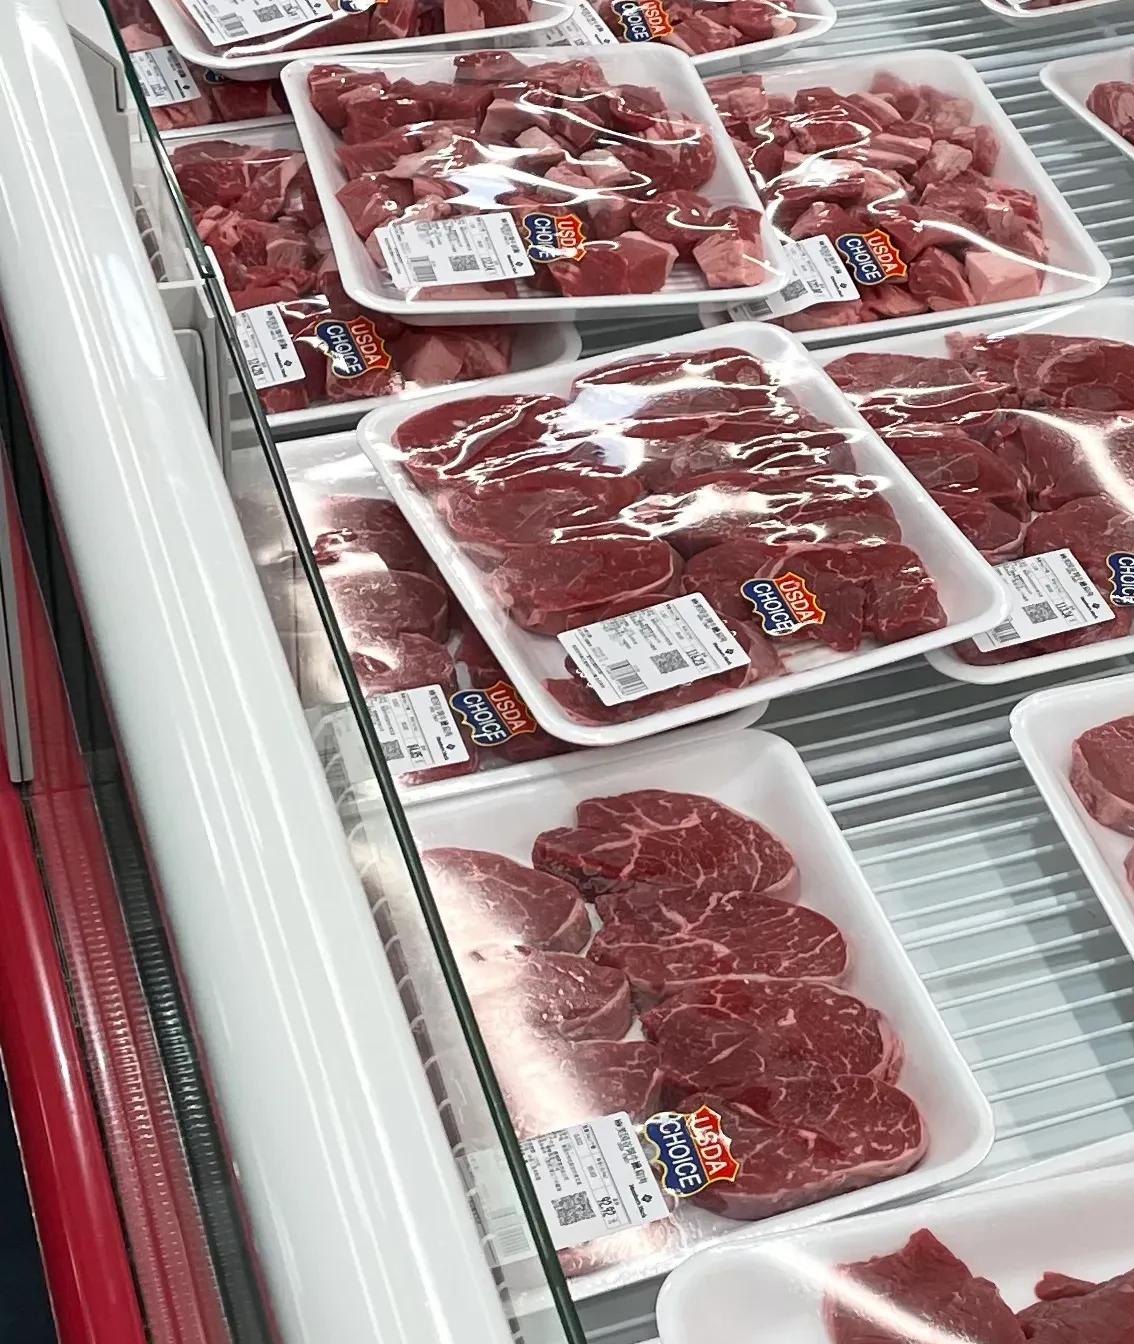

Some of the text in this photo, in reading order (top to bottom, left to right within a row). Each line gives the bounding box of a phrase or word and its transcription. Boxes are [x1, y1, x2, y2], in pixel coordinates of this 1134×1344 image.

[641, 1, 668, 37] USDA
[557, 221, 578, 256] USD
[846, 238, 882, 281] CHOICE
[868, 236, 898, 273] USDA
[350, 323, 382, 364] USDA
[753, 583, 796, 631] CHOICE
[778, 579, 815, 622] USDA
[463, 693, 507, 741] CHOICE
[490, 689, 526, 730] USDA
[658, 1117, 702, 1189] CHOICE
[690, 1116, 728, 1176] USDA
